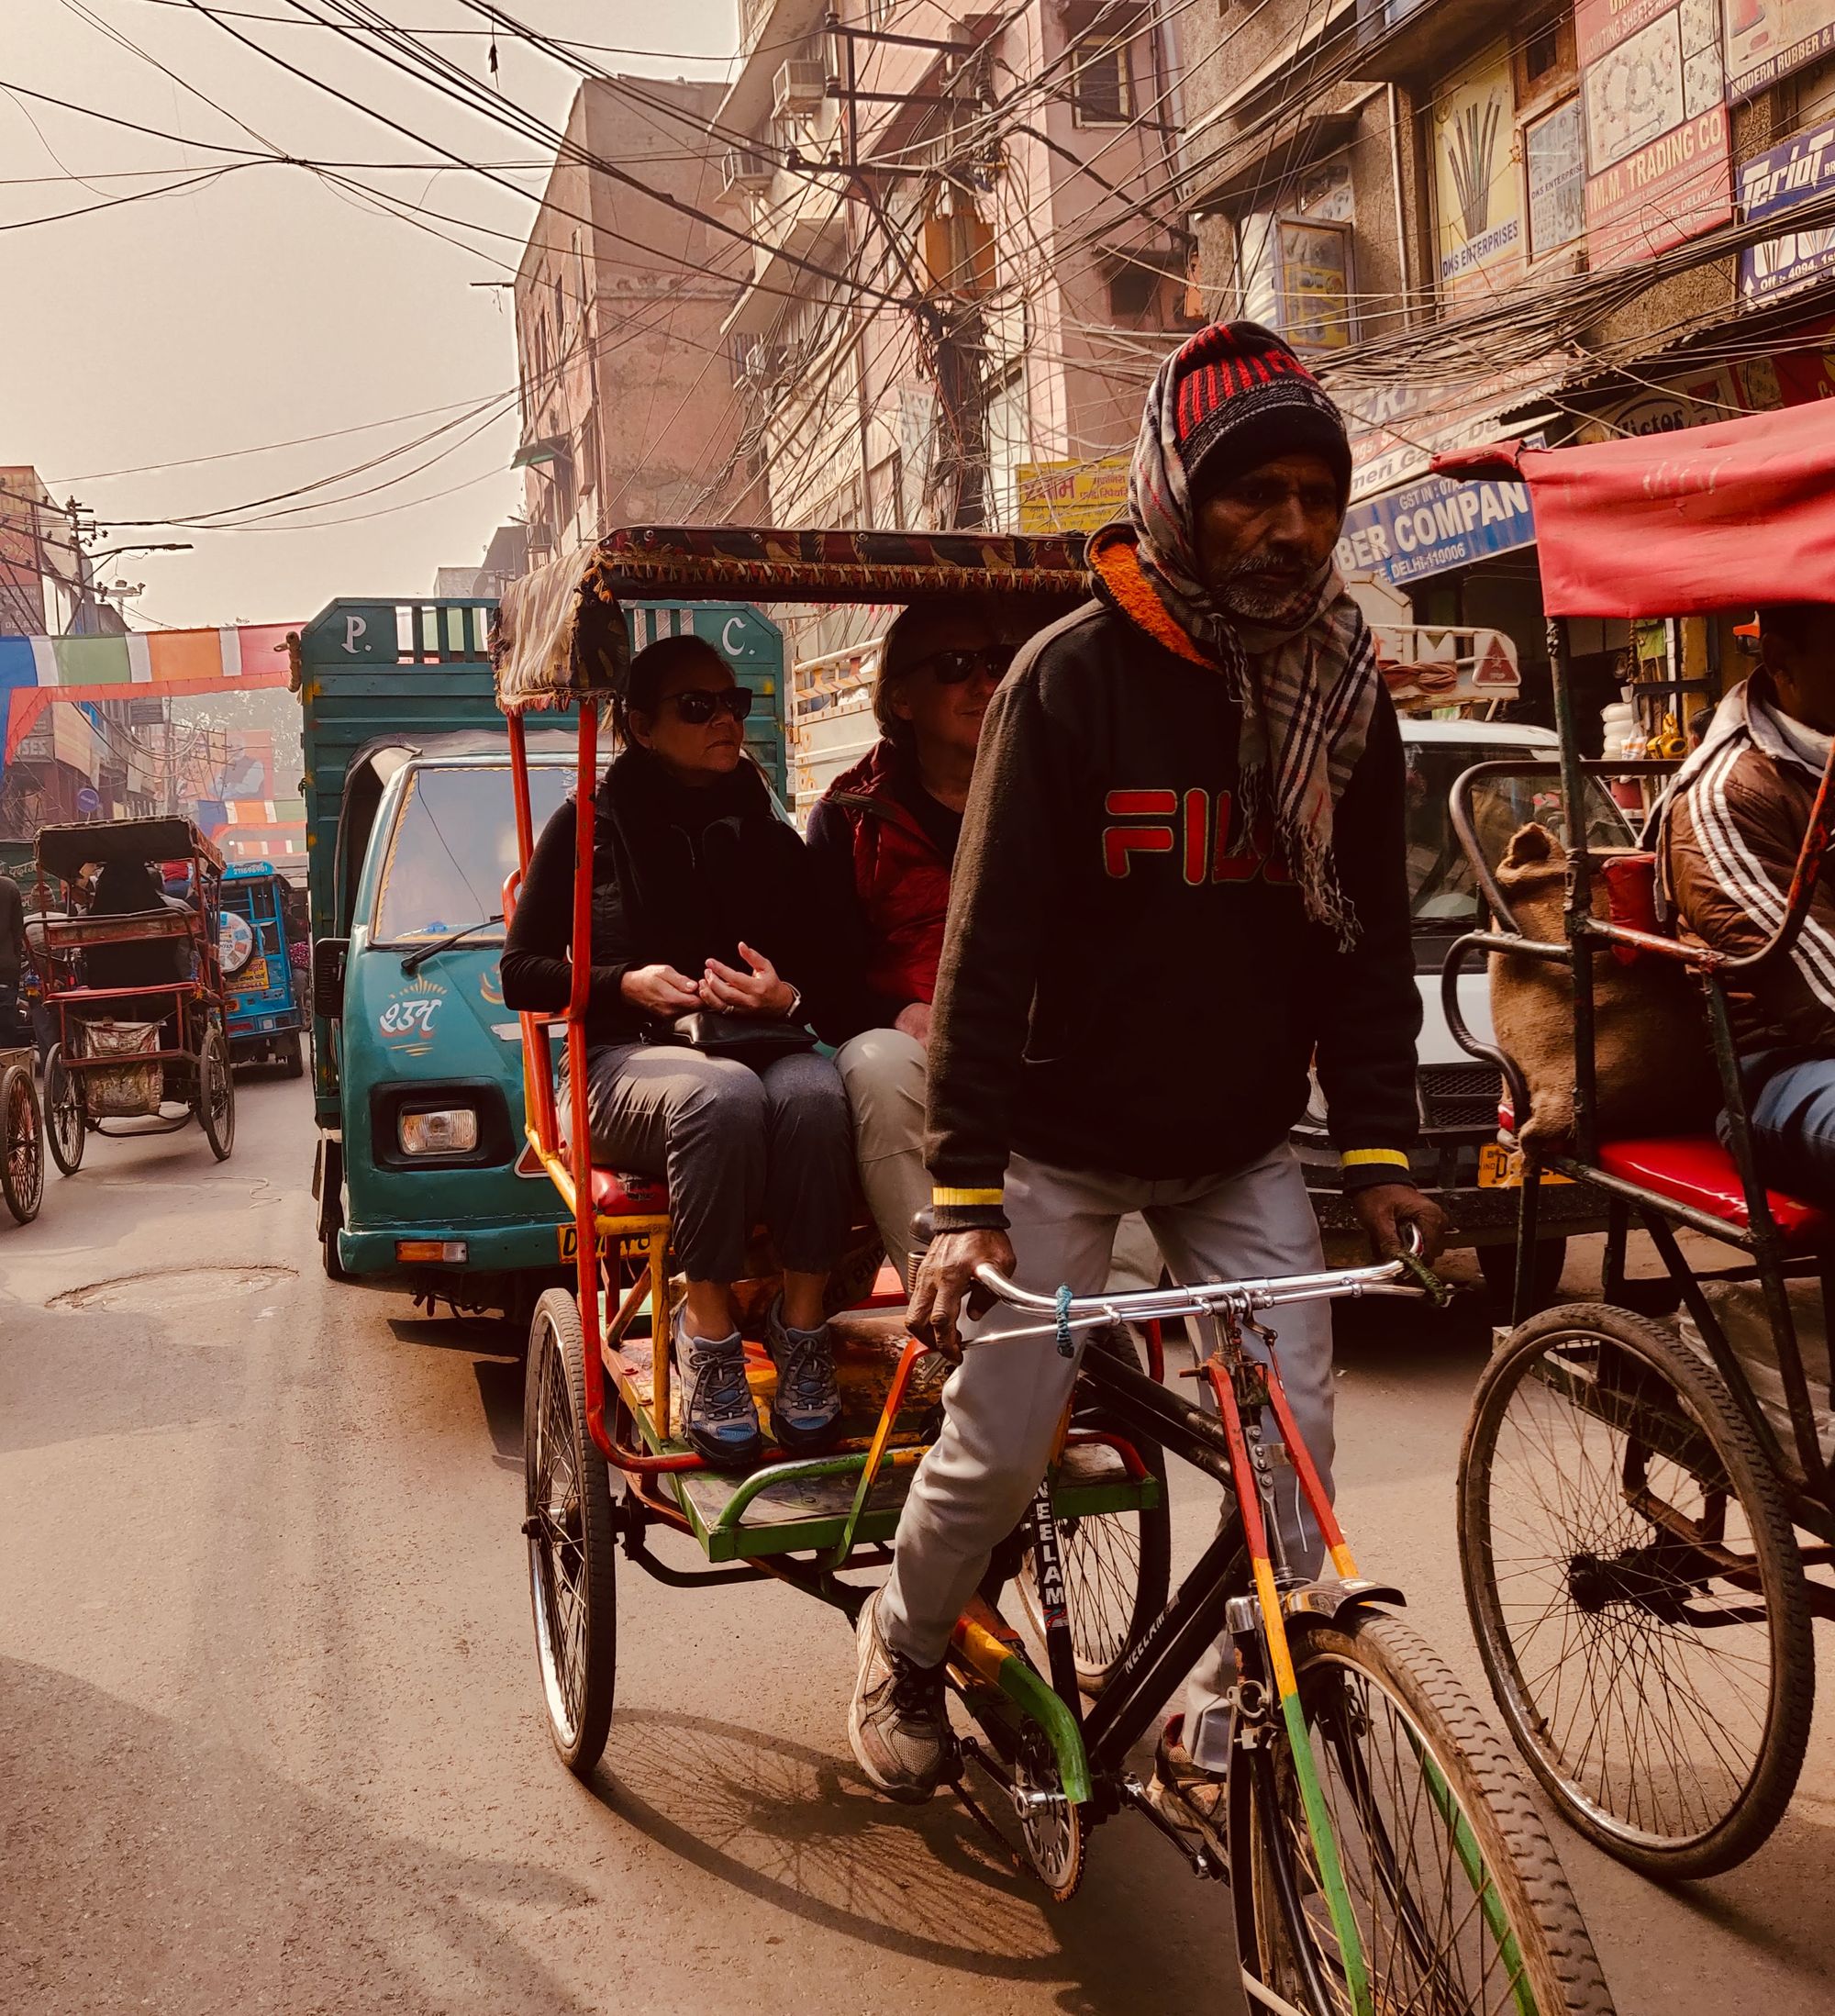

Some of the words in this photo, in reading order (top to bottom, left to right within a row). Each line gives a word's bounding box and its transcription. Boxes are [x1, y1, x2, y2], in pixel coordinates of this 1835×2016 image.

[1731, 59, 1775, 99] MODERN
[1776, 34, 1819, 73] RUBBER
[1822, 28, 1830, 47] &
[1627, 126, 1695, 190] TRADING
[1698, 111, 1725, 150] CO.
[1442, 256, 1460, 277] DKS
[1462, 219, 1518, 267] ENTERPRISES
[1399, 492, 1422, 511] GST
[1330, 524, 1391, 572] BER
[340, 616, 373, 654] P.
[722, 617, 756, 656] C.
[1032, 1479, 1066, 1606] NEELAM
